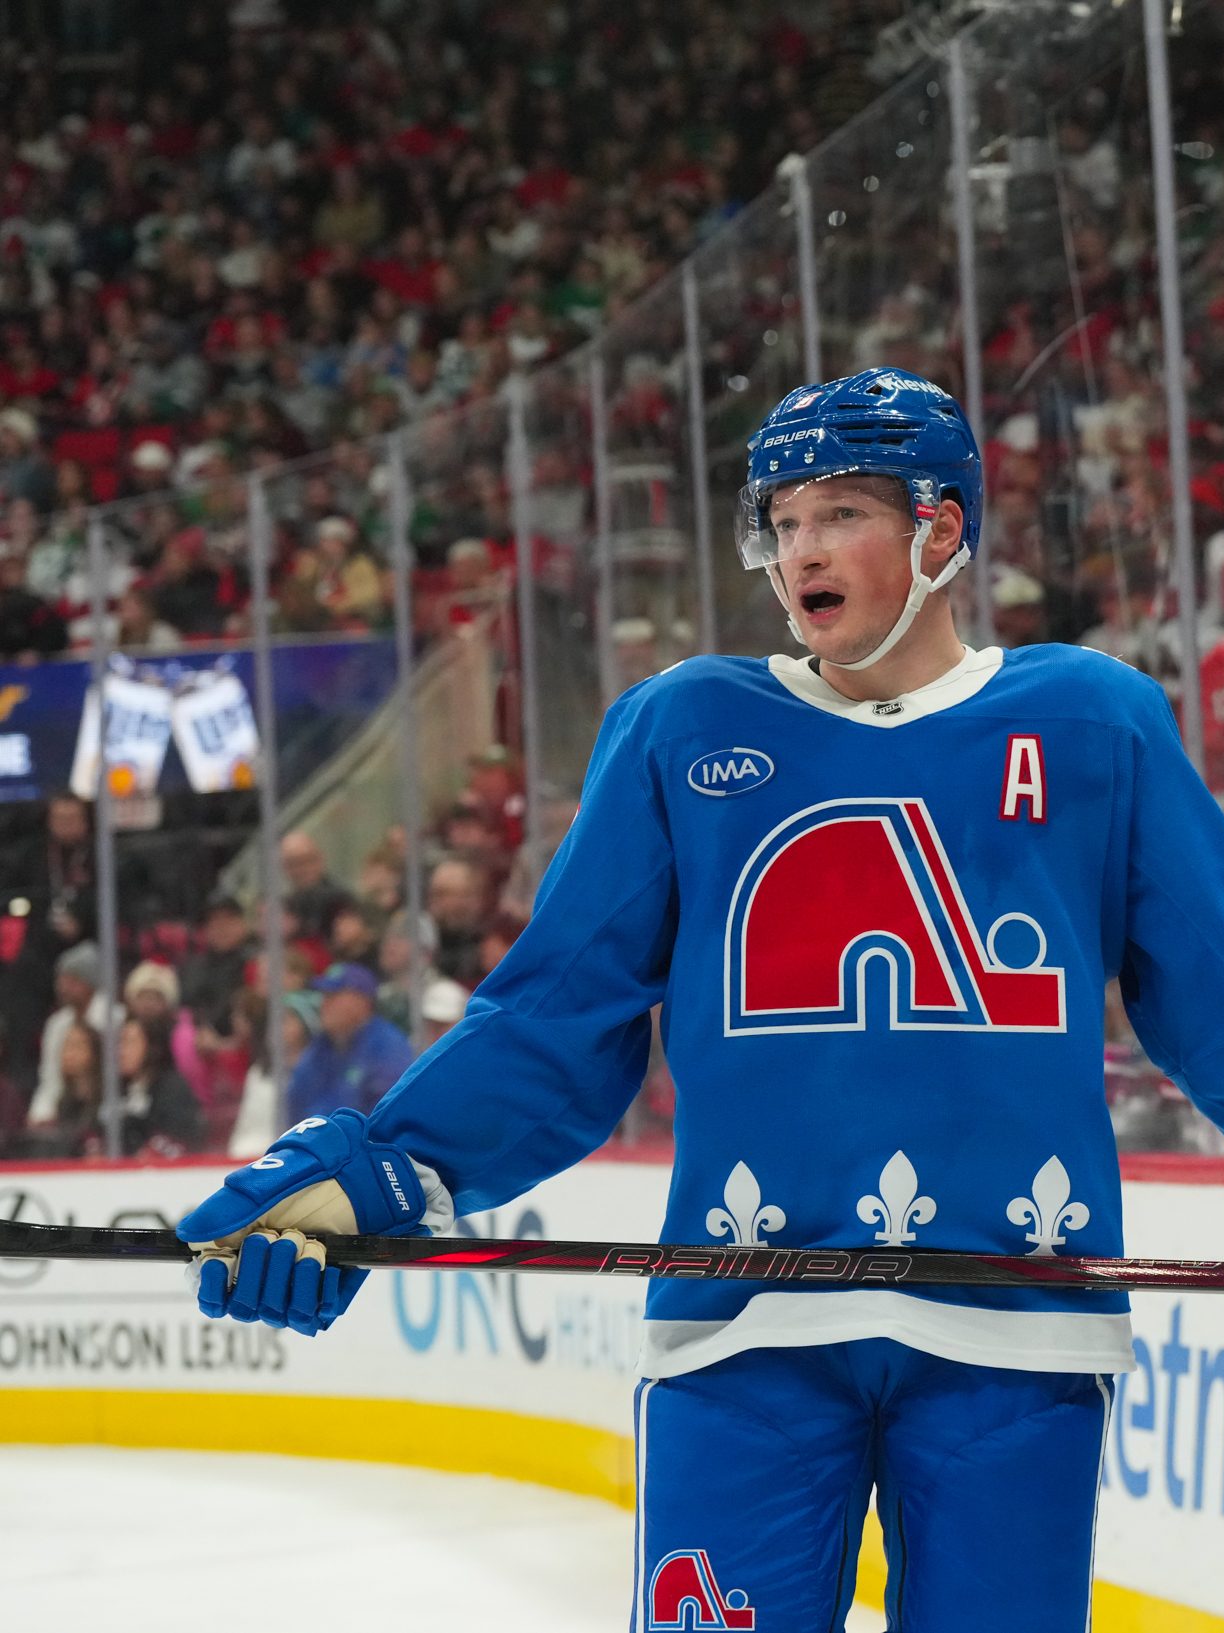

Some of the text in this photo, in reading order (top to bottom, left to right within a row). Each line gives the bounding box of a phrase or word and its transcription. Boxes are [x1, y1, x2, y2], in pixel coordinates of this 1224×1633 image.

[763, 428, 820, 448] BAUER
[702, 757, 760, 785] IMA
[999, 733, 1047, 824] A
[381, 1161, 410, 1211] BAUER
[179, 1321, 288, 1374] LEXUS
